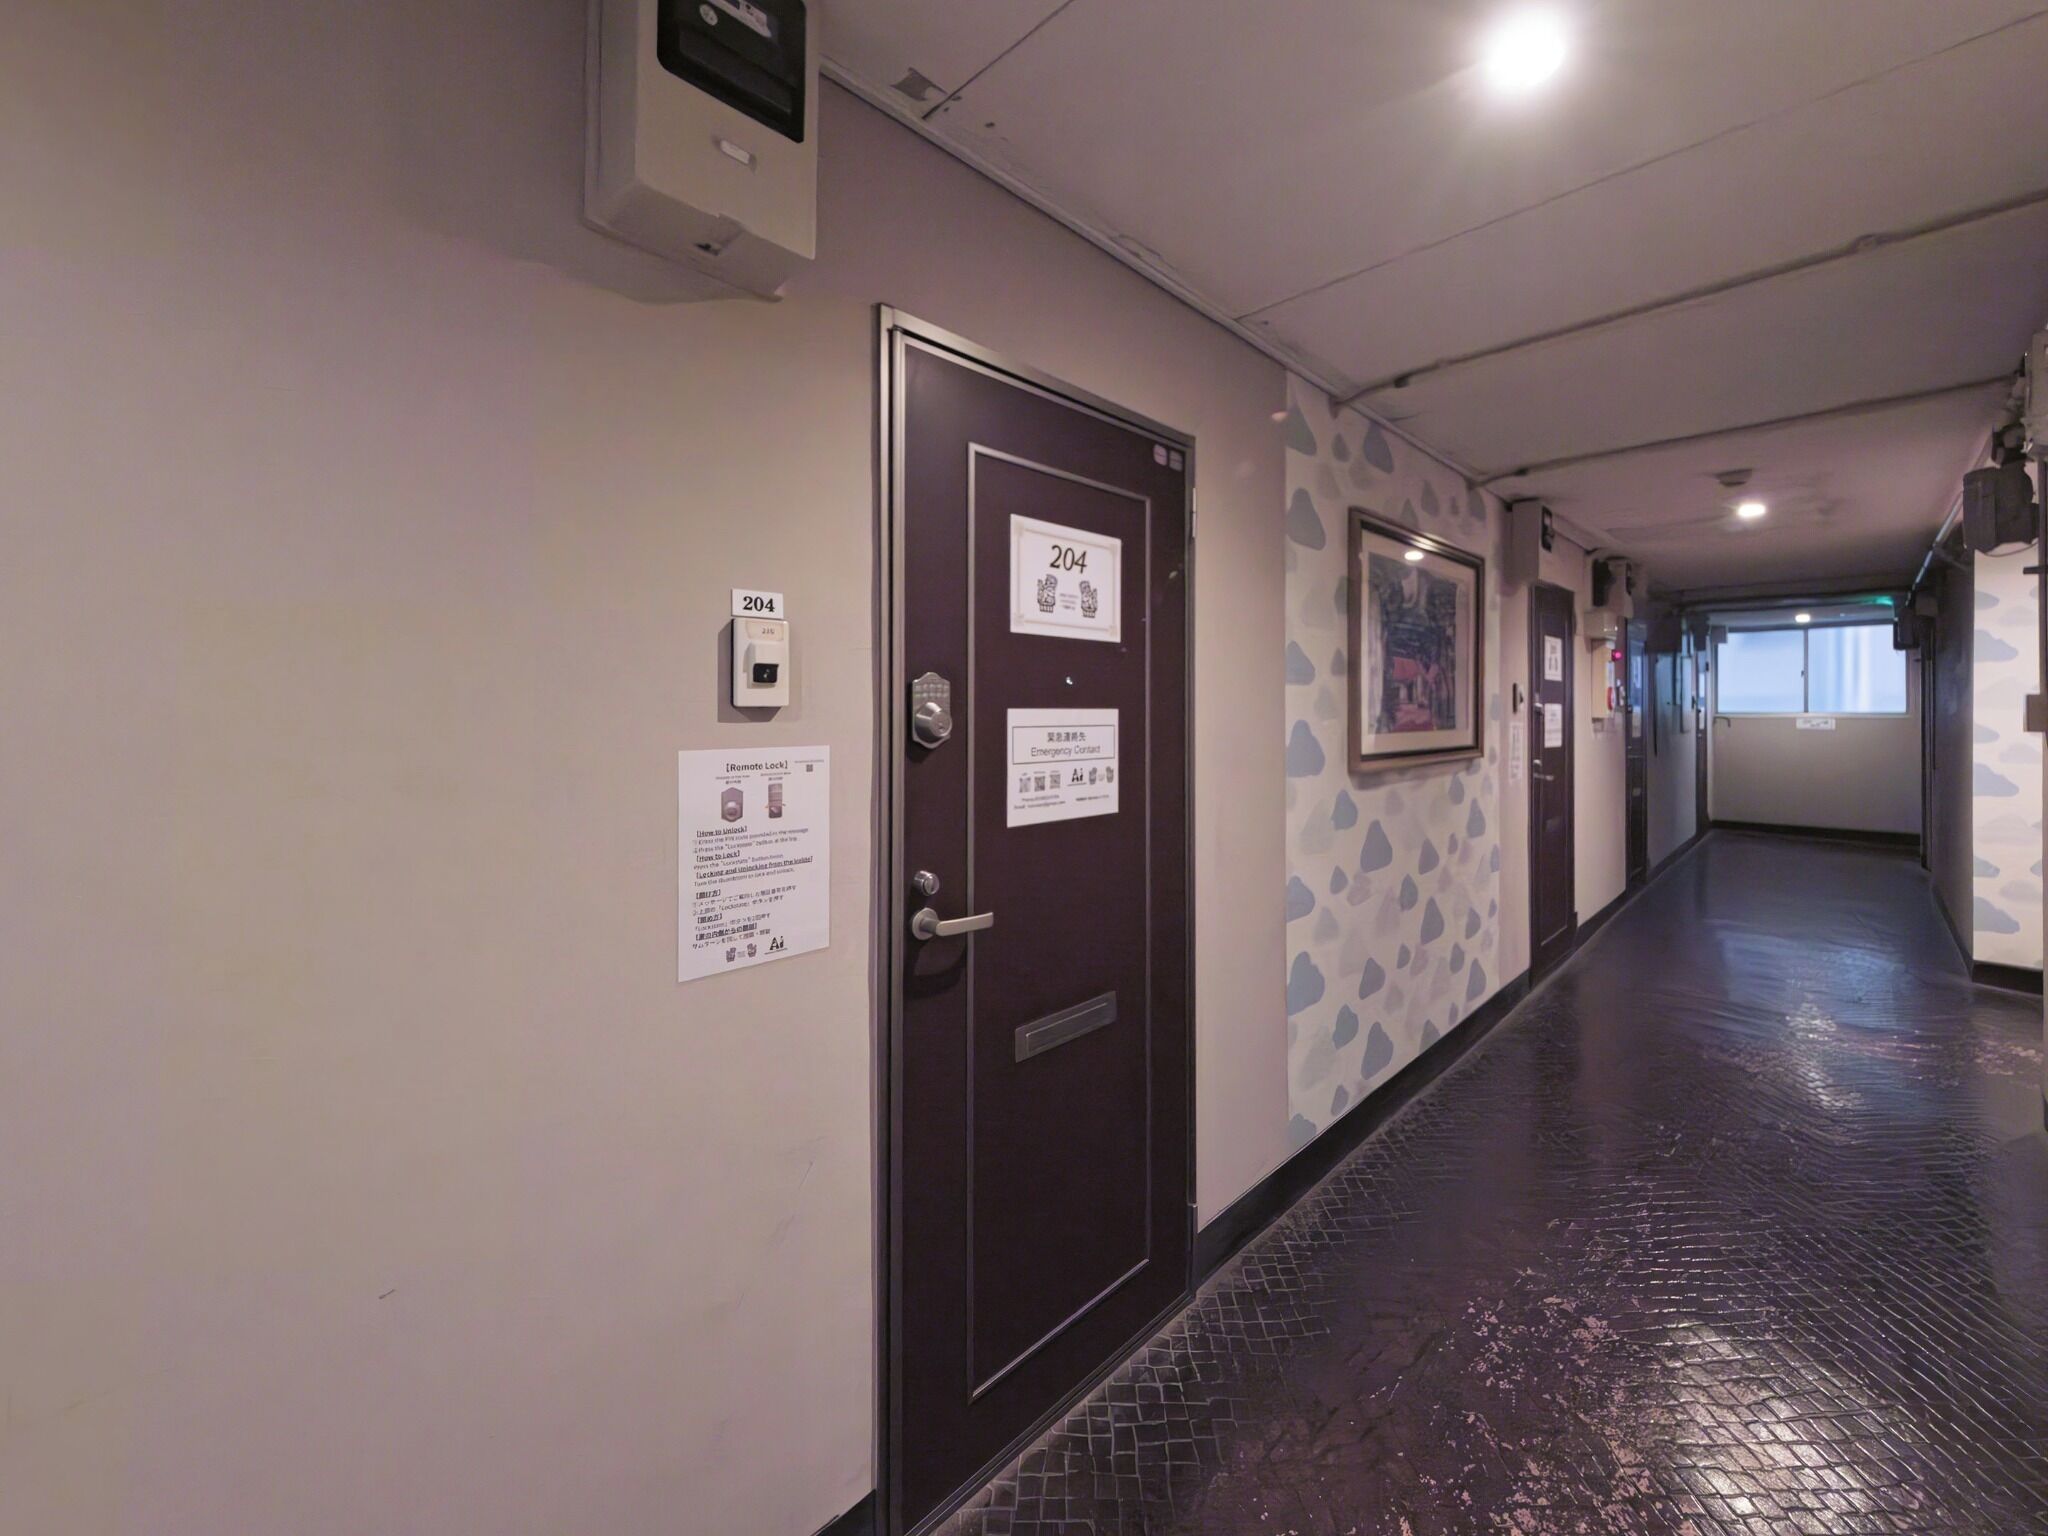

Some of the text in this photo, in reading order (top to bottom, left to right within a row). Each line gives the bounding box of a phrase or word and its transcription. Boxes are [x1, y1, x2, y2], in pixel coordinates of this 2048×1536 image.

[1049, 545, 1088, 574] 204
[743, 596, 775, 612] 204
[1031, 745, 1101, 758] Emergency Contact
